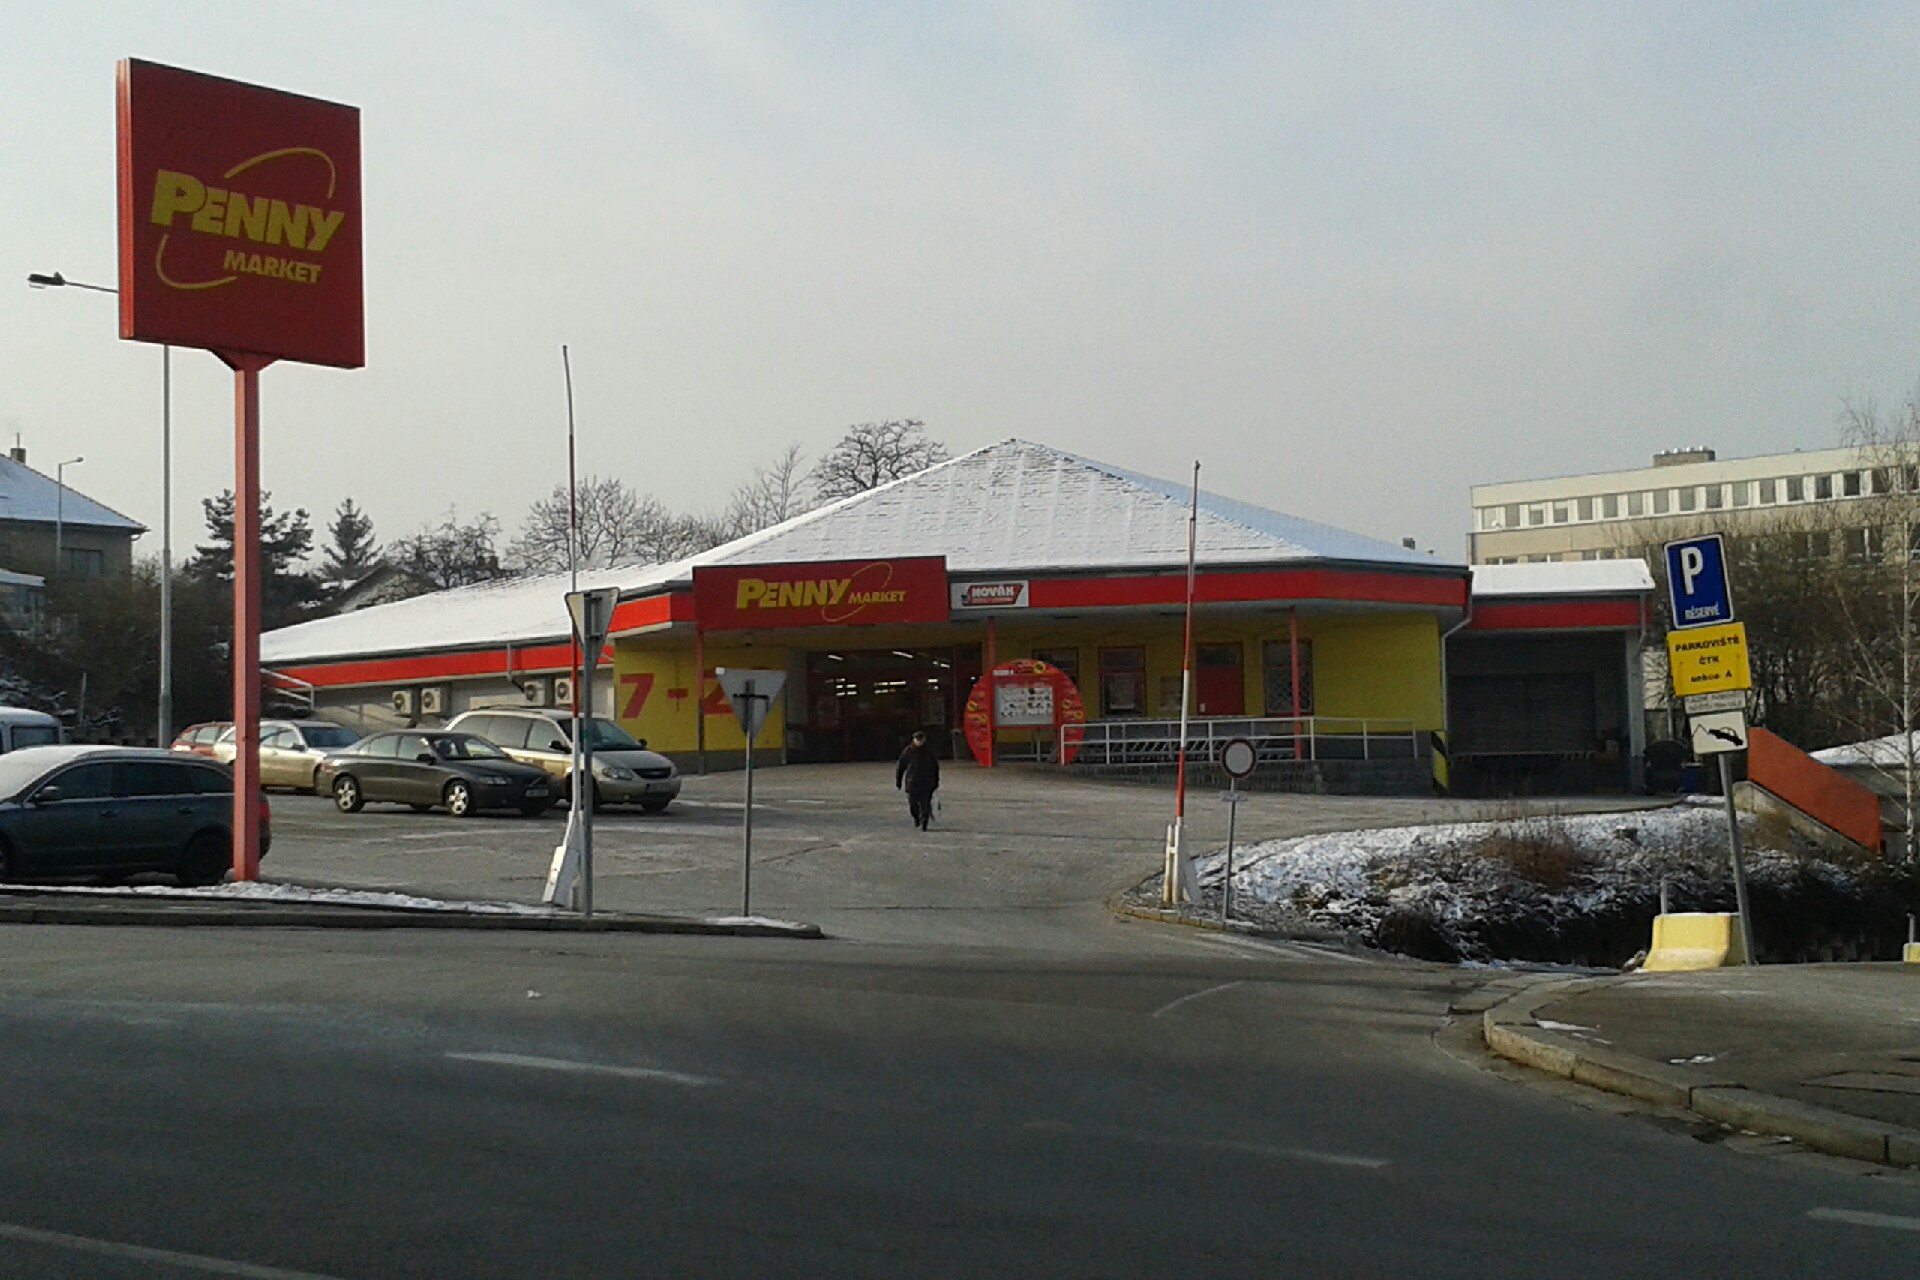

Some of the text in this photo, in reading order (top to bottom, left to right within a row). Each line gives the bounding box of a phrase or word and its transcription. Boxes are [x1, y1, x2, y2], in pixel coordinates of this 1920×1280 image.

[151, 169, 344, 251] PENNY
[223, 250, 322, 283] MARKET
[1681, 547, 1703, 595] P
[736, 579, 906, 608] PENNY MARKET
